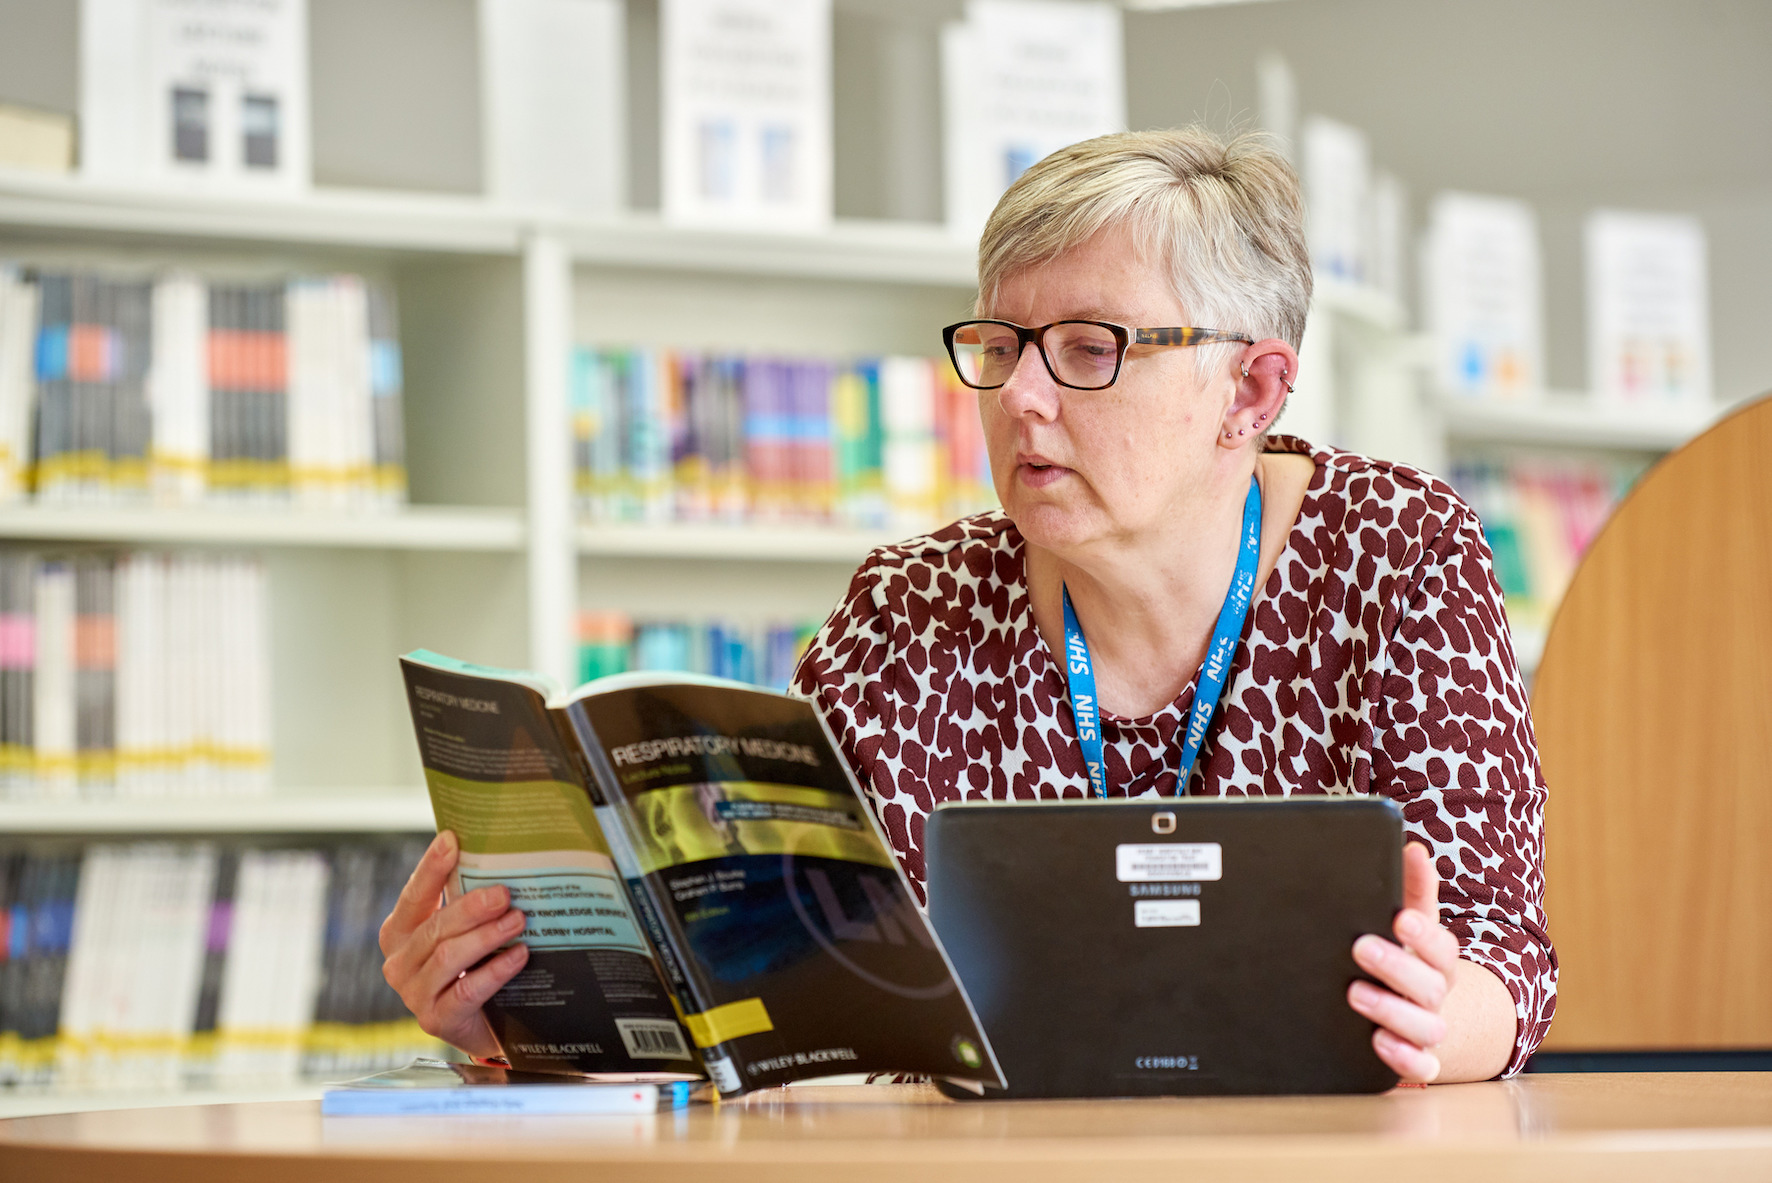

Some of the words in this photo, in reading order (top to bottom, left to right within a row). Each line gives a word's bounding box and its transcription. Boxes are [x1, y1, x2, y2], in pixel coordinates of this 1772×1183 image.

[1074, 694, 1097, 742] NHS
[1188, 699, 1213, 749] NHS
[611, 735, 741, 767] RESPIRATORY
[739, 737, 821, 767] MEDICINE
[1129, 884, 1201, 896] SAMSUNG
[537, 908, 593, 918] KNOWLEDGE
[595, 908, 628, 919] SERVICE
[541, 928, 571, 937] DERBY
[572, 926, 617, 936] HOSPITAL
[518, 1042, 604, 1054] WILEY-BLACKWELL
[757, 1047, 859, 1072] WILEY-BLACKWELL
